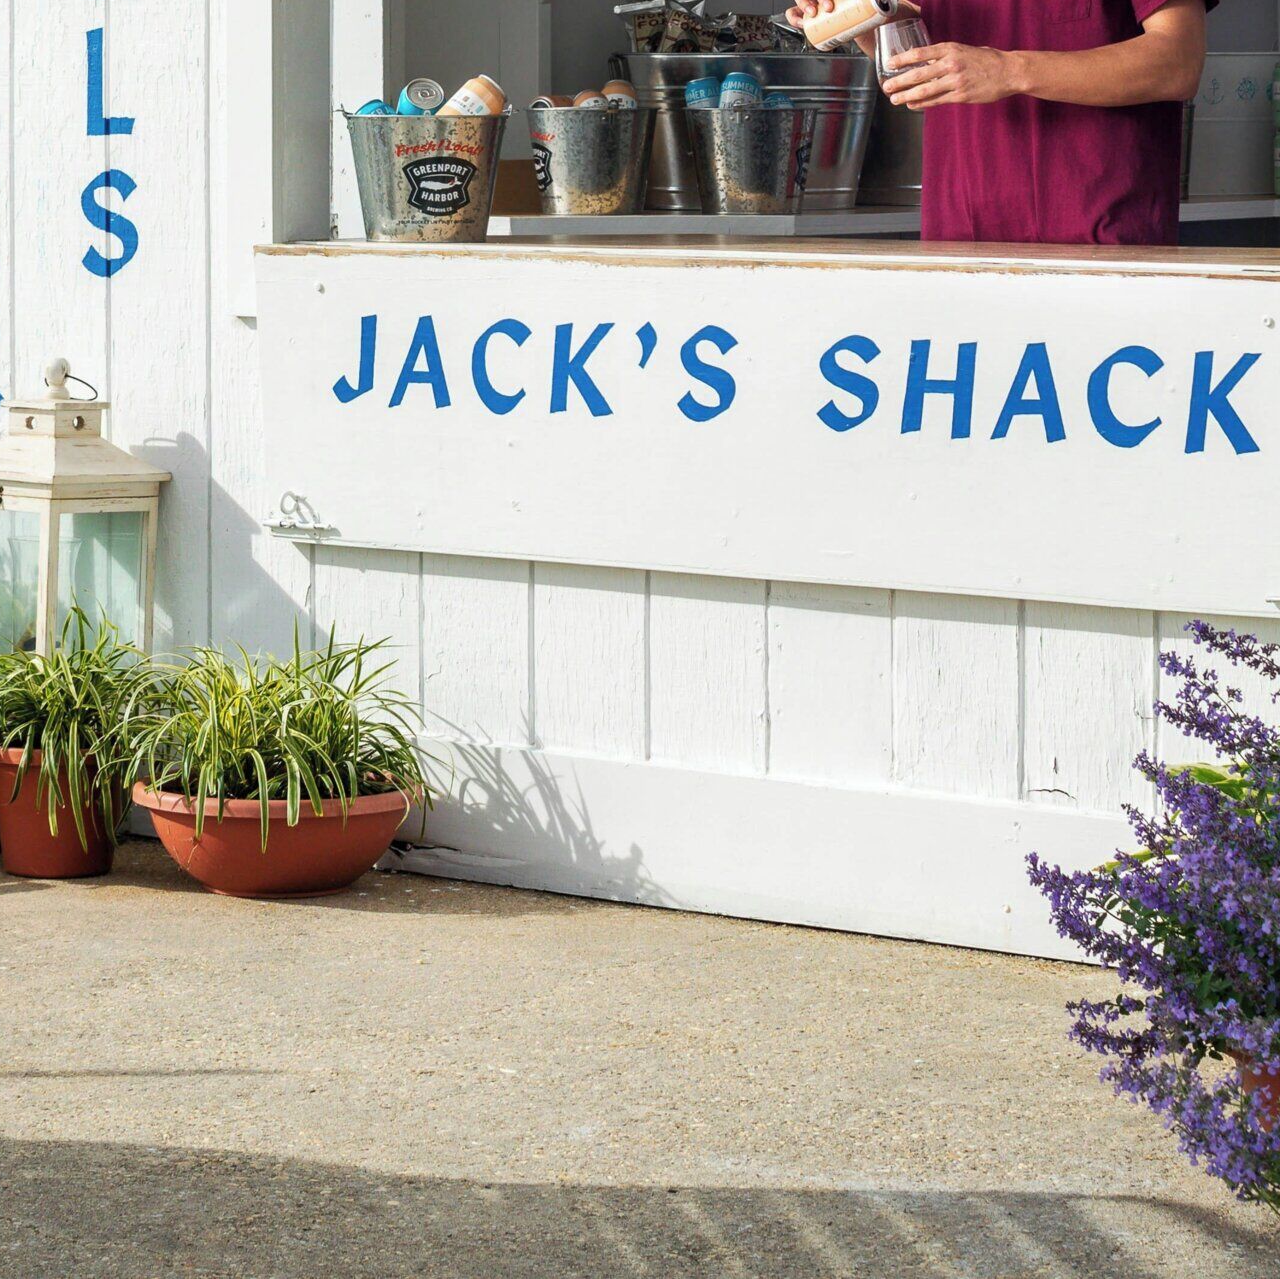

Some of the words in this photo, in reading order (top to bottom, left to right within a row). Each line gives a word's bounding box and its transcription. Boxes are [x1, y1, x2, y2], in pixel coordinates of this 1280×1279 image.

[395, 138, 445, 157] Fresh!
[446, 139, 484, 156] Local!
[413, 163, 468, 177] GREENPORT
[421, 191, 460, 202] HARBOR
[332, 315, 738, 422] JACK'S
[817, 335, 1262, 454] SHACK
